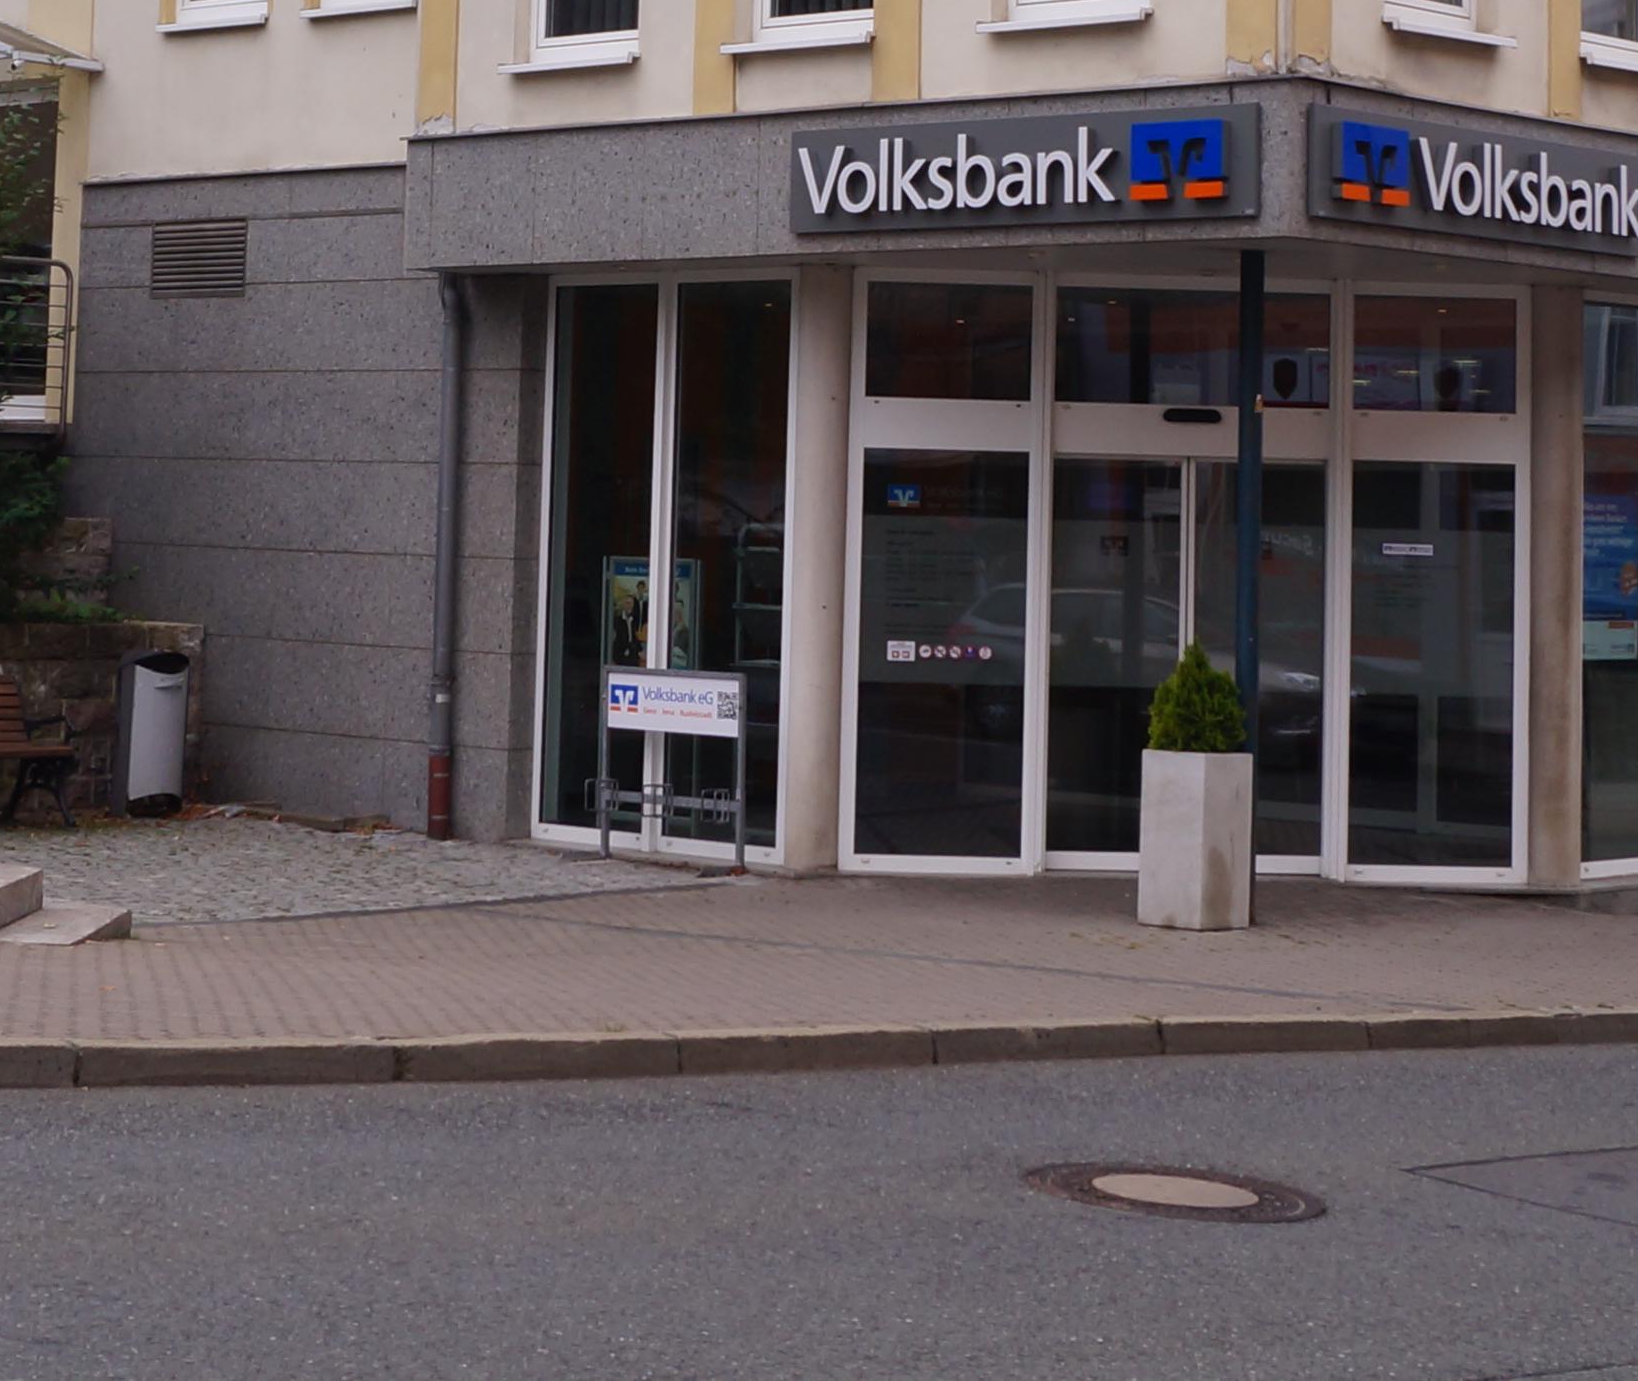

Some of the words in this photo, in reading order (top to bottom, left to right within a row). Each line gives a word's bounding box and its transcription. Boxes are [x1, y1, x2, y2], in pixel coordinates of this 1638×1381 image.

[798, 126, 1116, 214] Volksbank
[642, 685, 696, 704] Volksbank
[698, 690, 714, 706] eG
